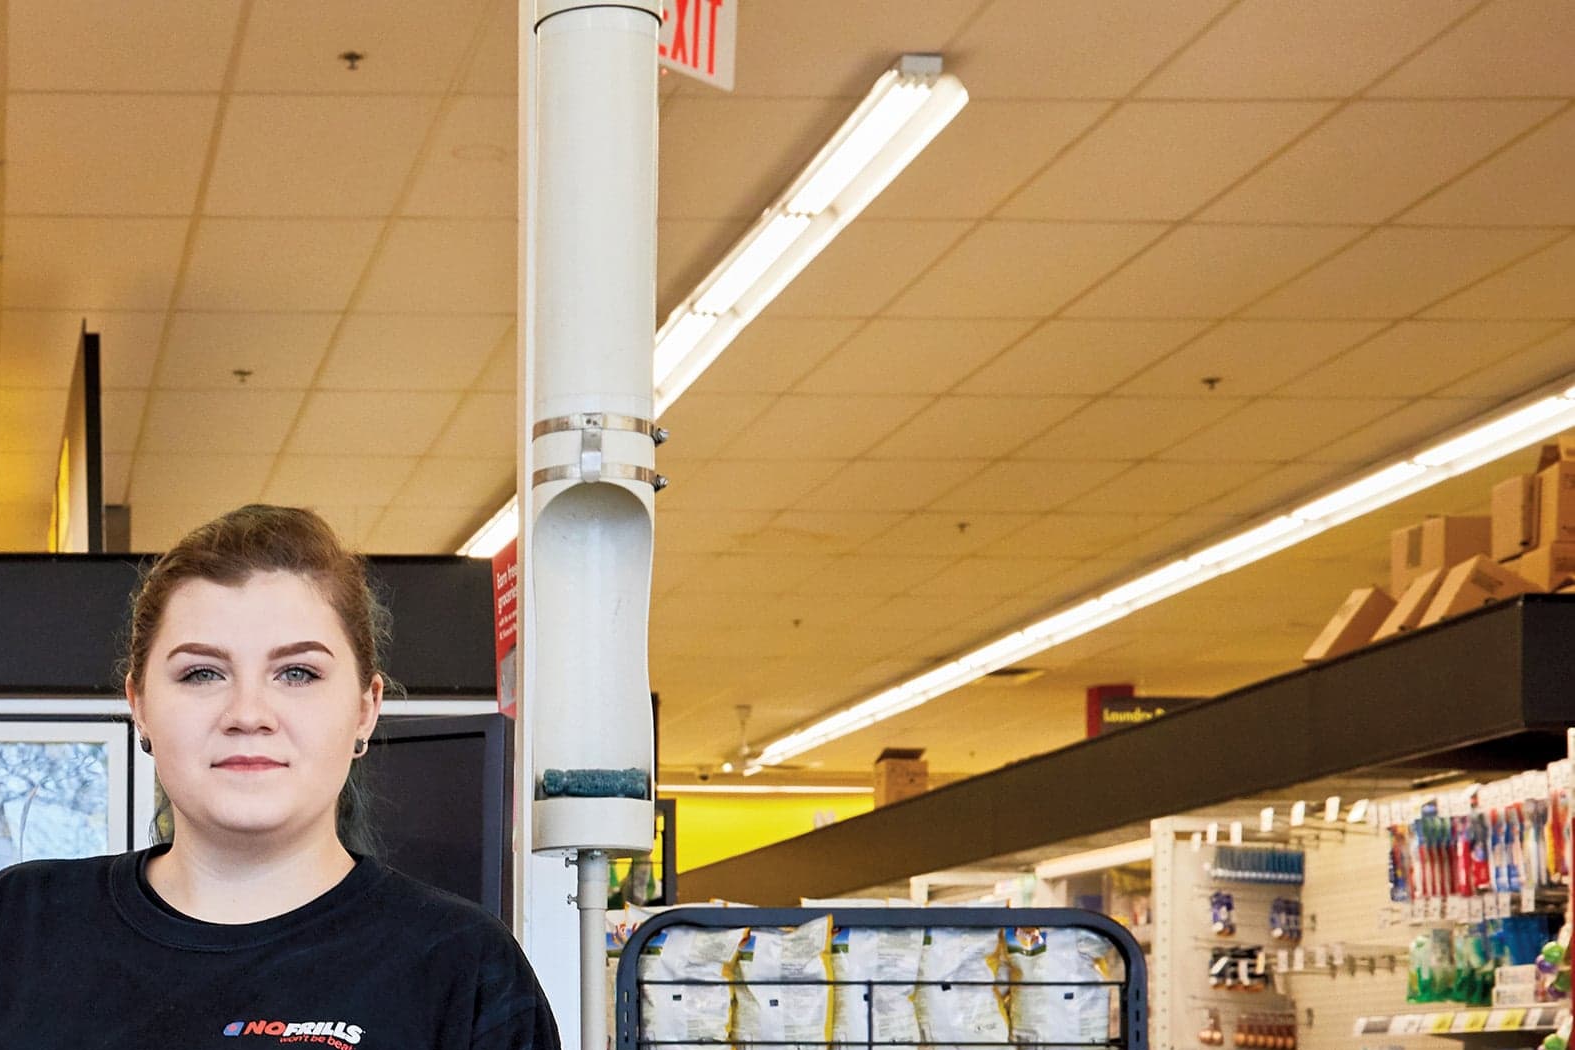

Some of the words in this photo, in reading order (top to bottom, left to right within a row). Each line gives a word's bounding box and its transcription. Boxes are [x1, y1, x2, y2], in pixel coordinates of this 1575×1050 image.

[658, 0, 723, 76] XIT
[279, 1033, 309, 1044] won't
[310, 1035, 326, 1043] be
